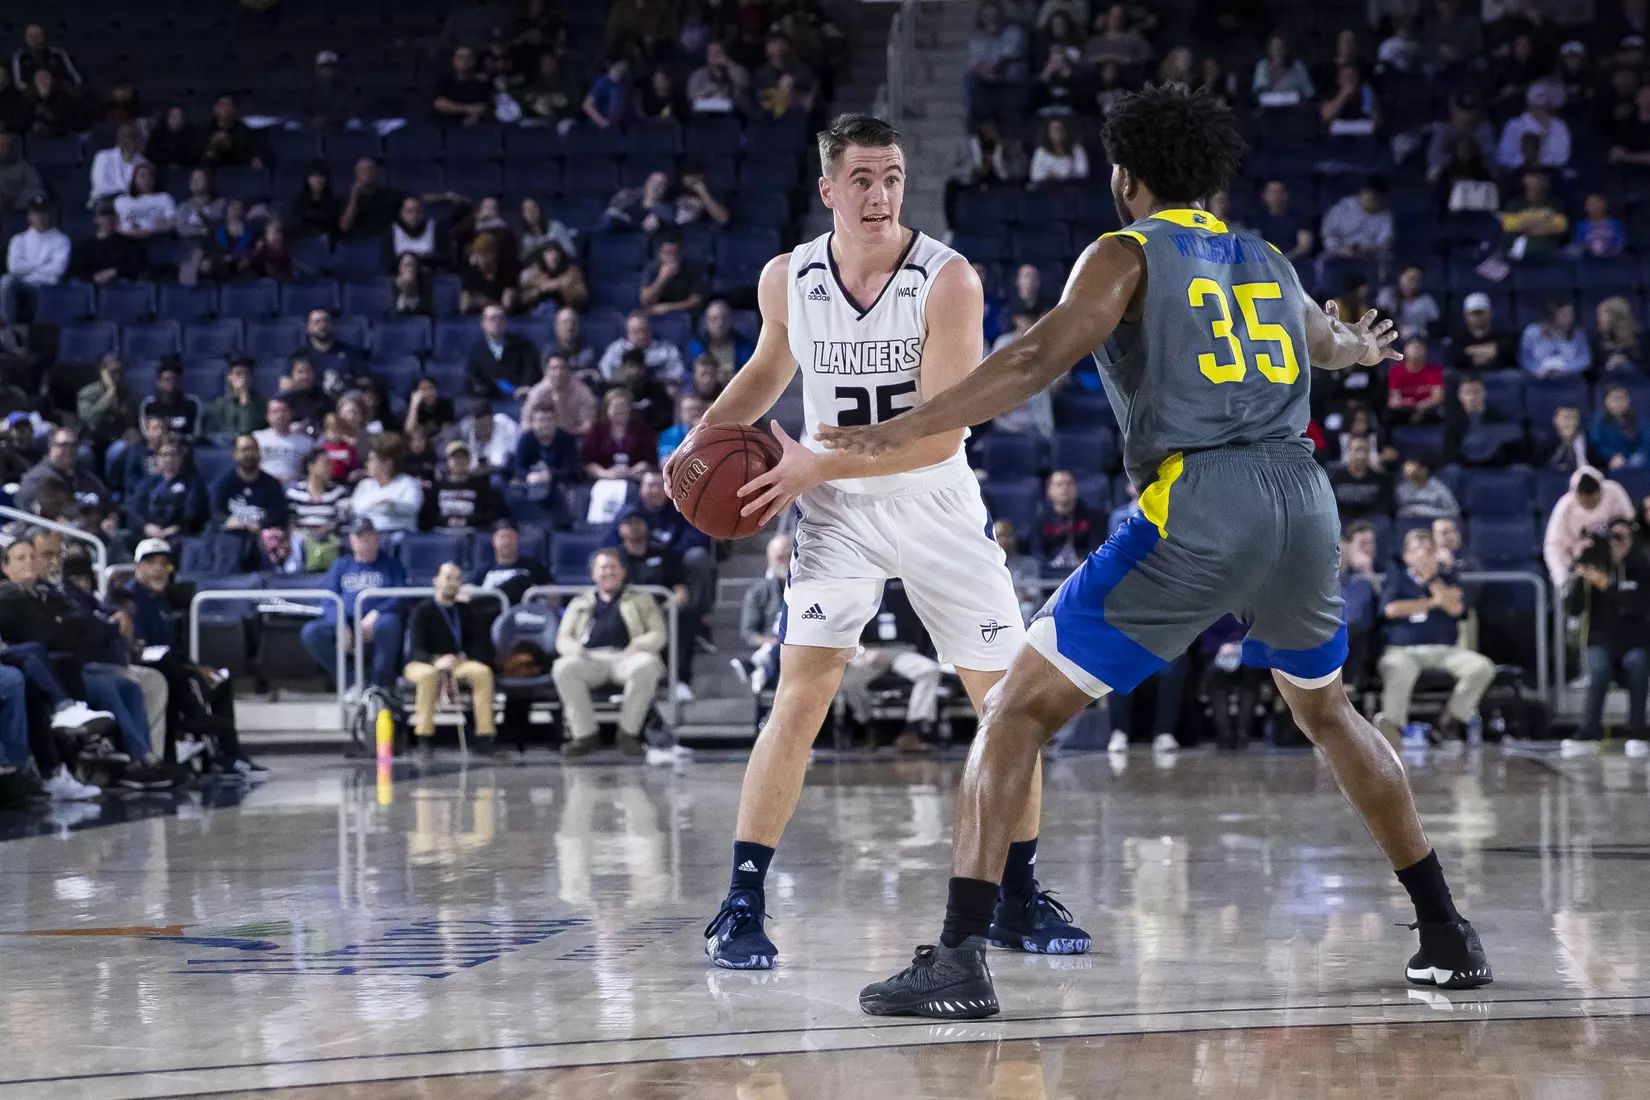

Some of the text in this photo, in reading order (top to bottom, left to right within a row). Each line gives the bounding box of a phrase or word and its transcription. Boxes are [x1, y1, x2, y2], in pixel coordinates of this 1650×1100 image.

[807, 294, 831, 302] adidas
[897, 287, 919, 298] WAC
[1187, 277, 1300, 385] 35
[813, 337, 921, 375] LANCERS
[801, 612, 827, 621] adidas
